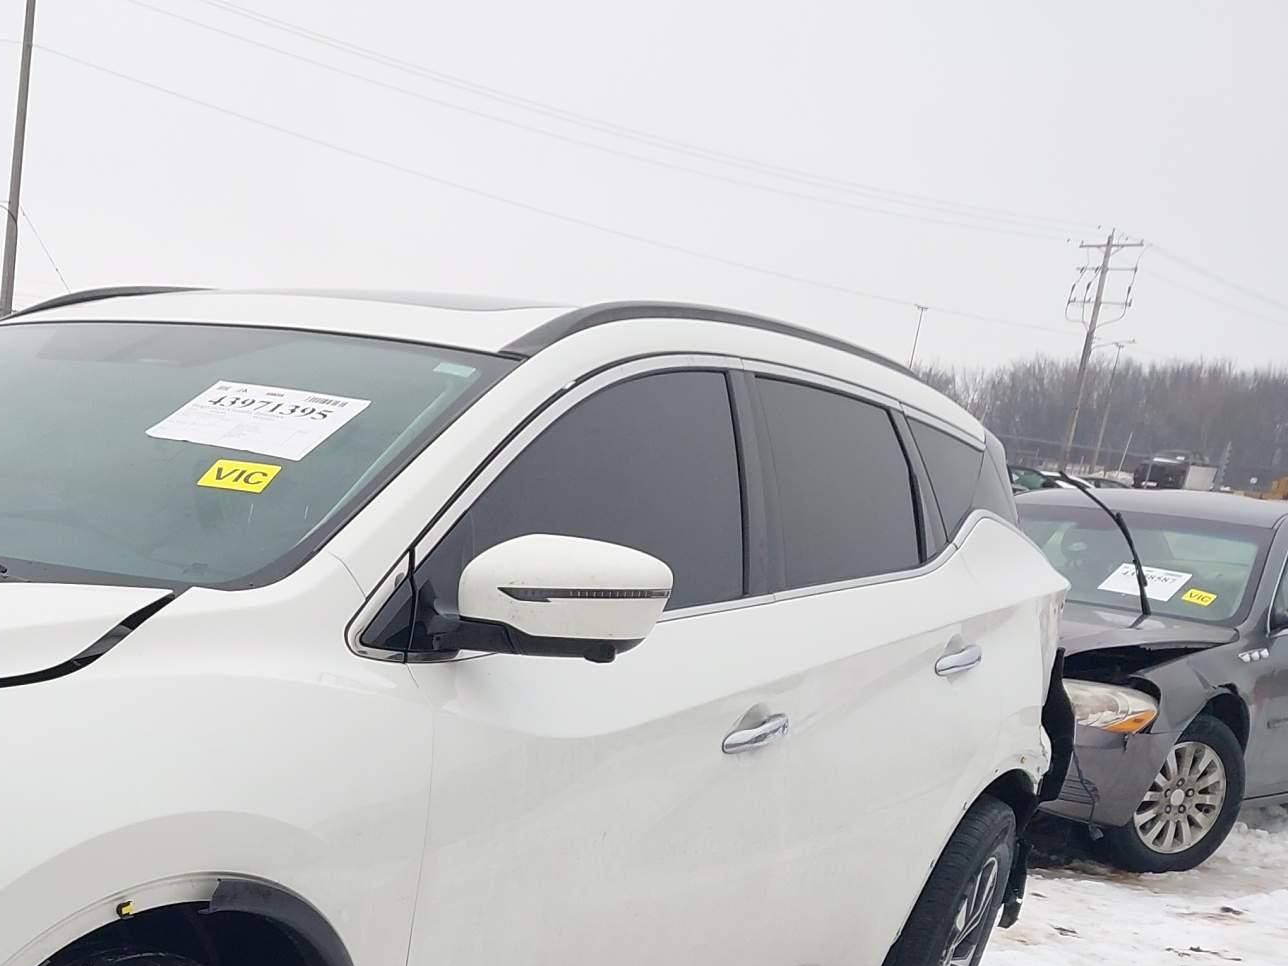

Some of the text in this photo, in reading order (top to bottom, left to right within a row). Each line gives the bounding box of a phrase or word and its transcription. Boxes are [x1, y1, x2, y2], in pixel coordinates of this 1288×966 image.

[208, 395, 334, 421] 43971395
[215, 467, 268, 485] VIC
[1189, 592, 1212, 603] VIC
